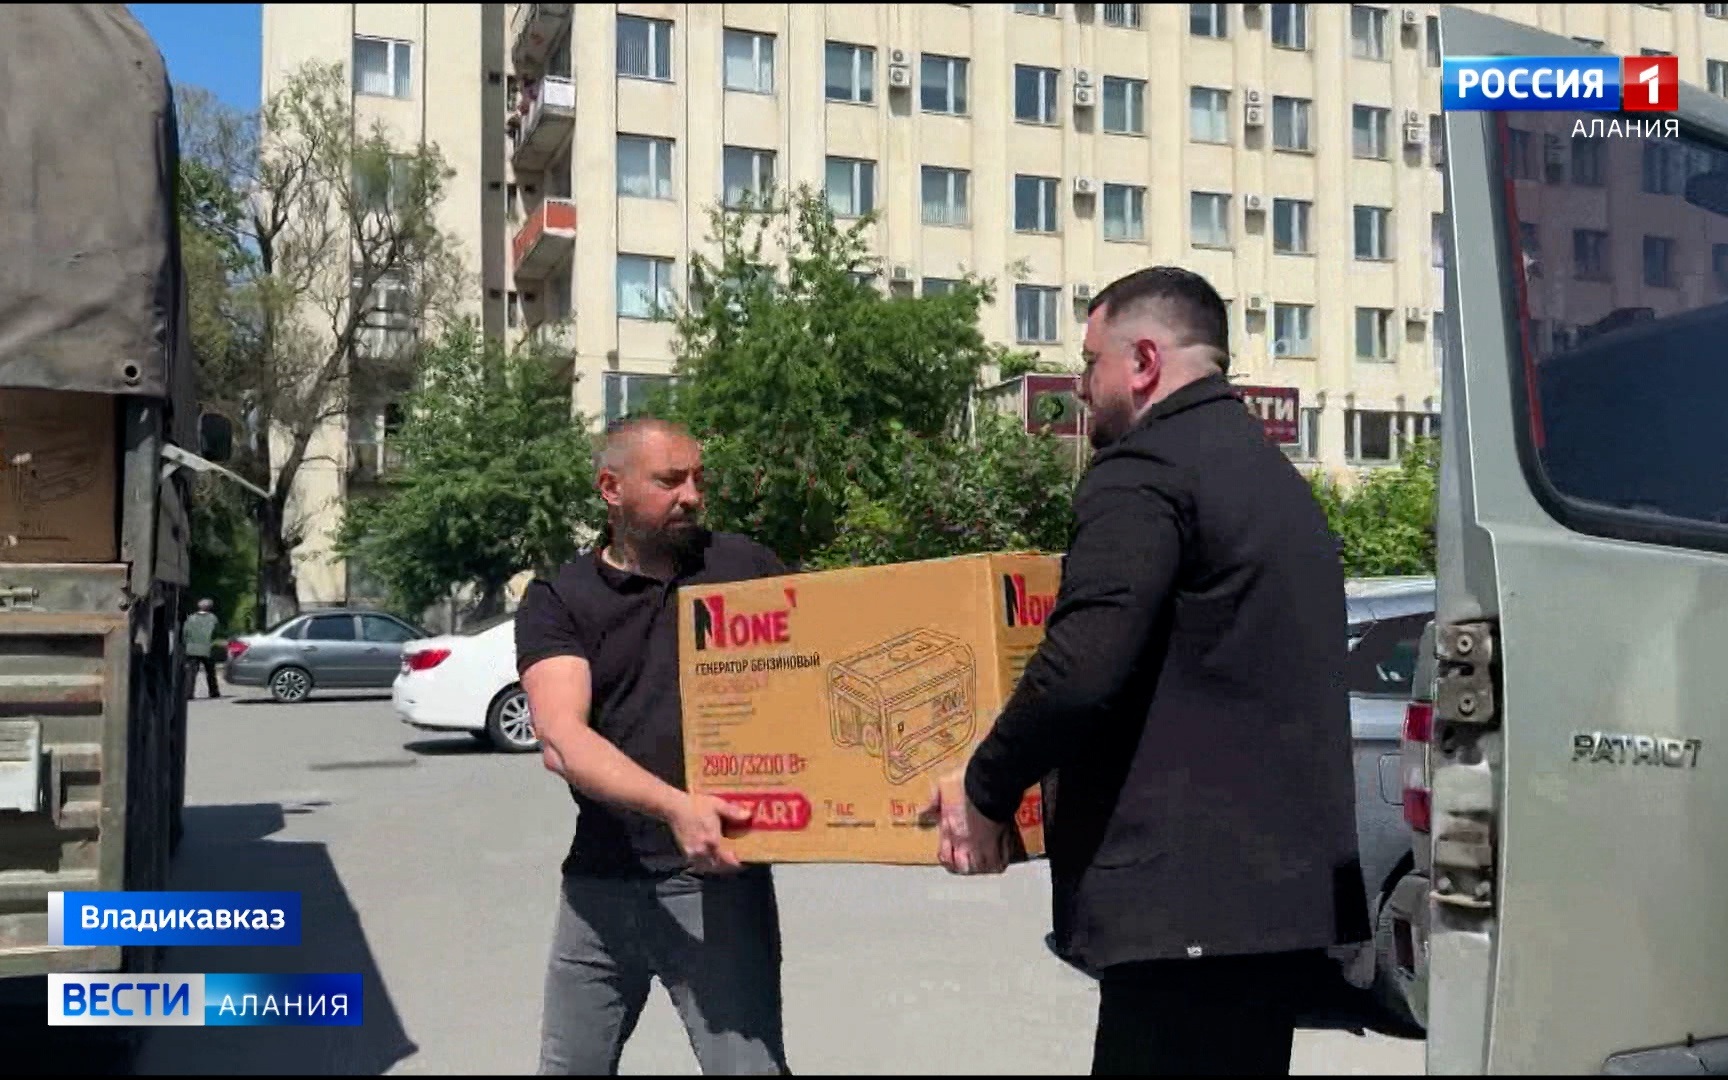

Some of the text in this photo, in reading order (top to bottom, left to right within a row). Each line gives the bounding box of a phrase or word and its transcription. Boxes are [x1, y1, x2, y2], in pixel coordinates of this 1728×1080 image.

[695, 652, 821, 676] ГЕНЕРАТОР БЕНЗИНОВЫЙ
[1572, 731, 1703, 768] PATRIOT
